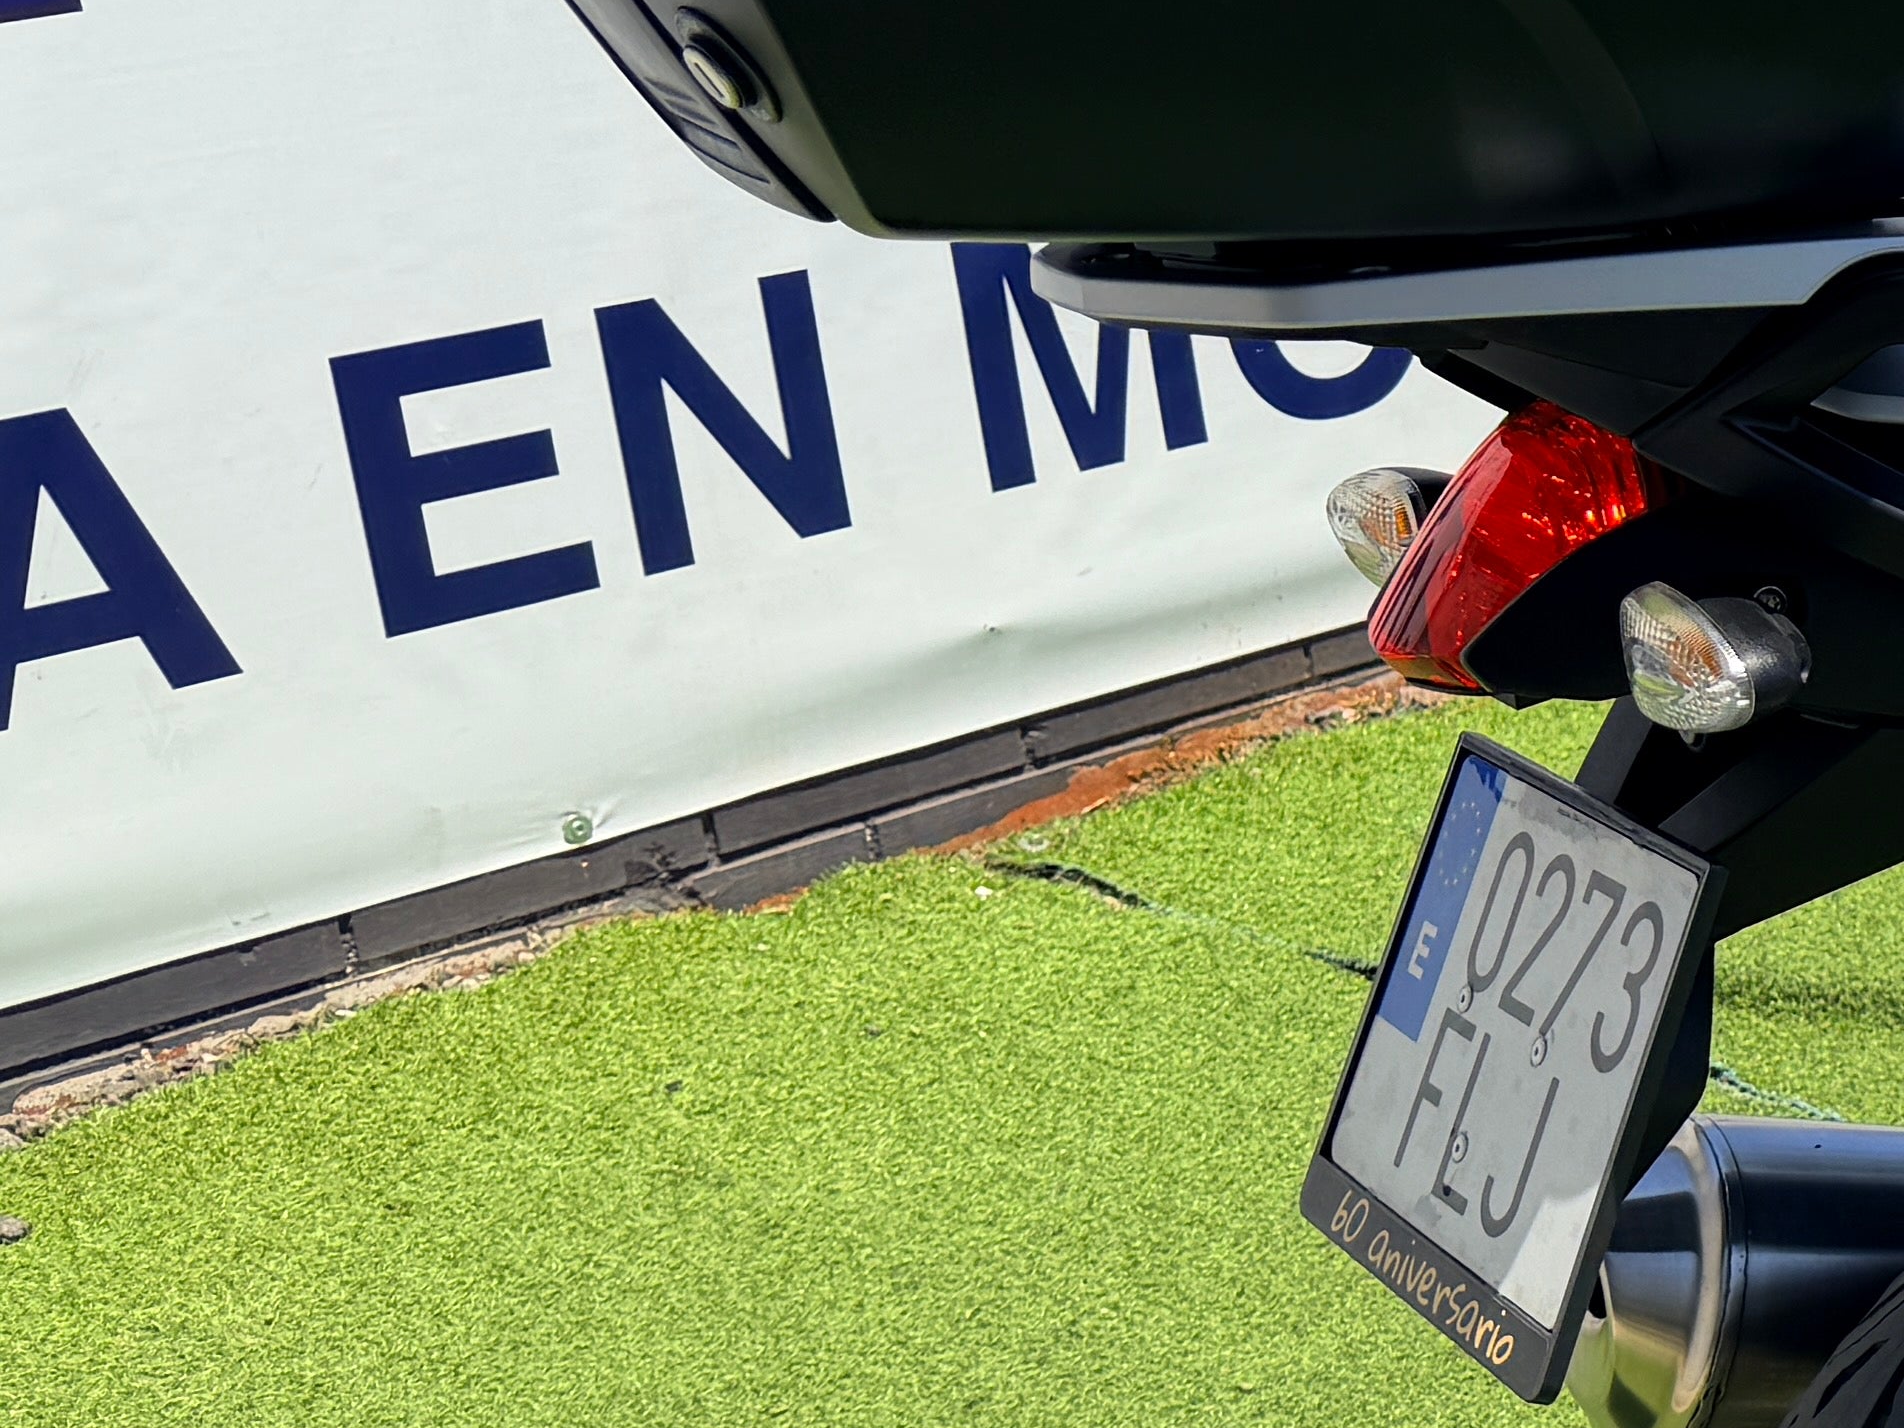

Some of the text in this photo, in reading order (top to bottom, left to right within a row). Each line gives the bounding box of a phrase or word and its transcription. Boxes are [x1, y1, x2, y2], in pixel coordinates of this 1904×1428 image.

[329, 269, 852, 638] EN
[1406, 920, 1438, 980] E
[1467, 830, 1665, 1074] 0273
[1394, 1006, 1561, 1239] FLJ
[1366, 1227, 1515, 1366] aniversario
